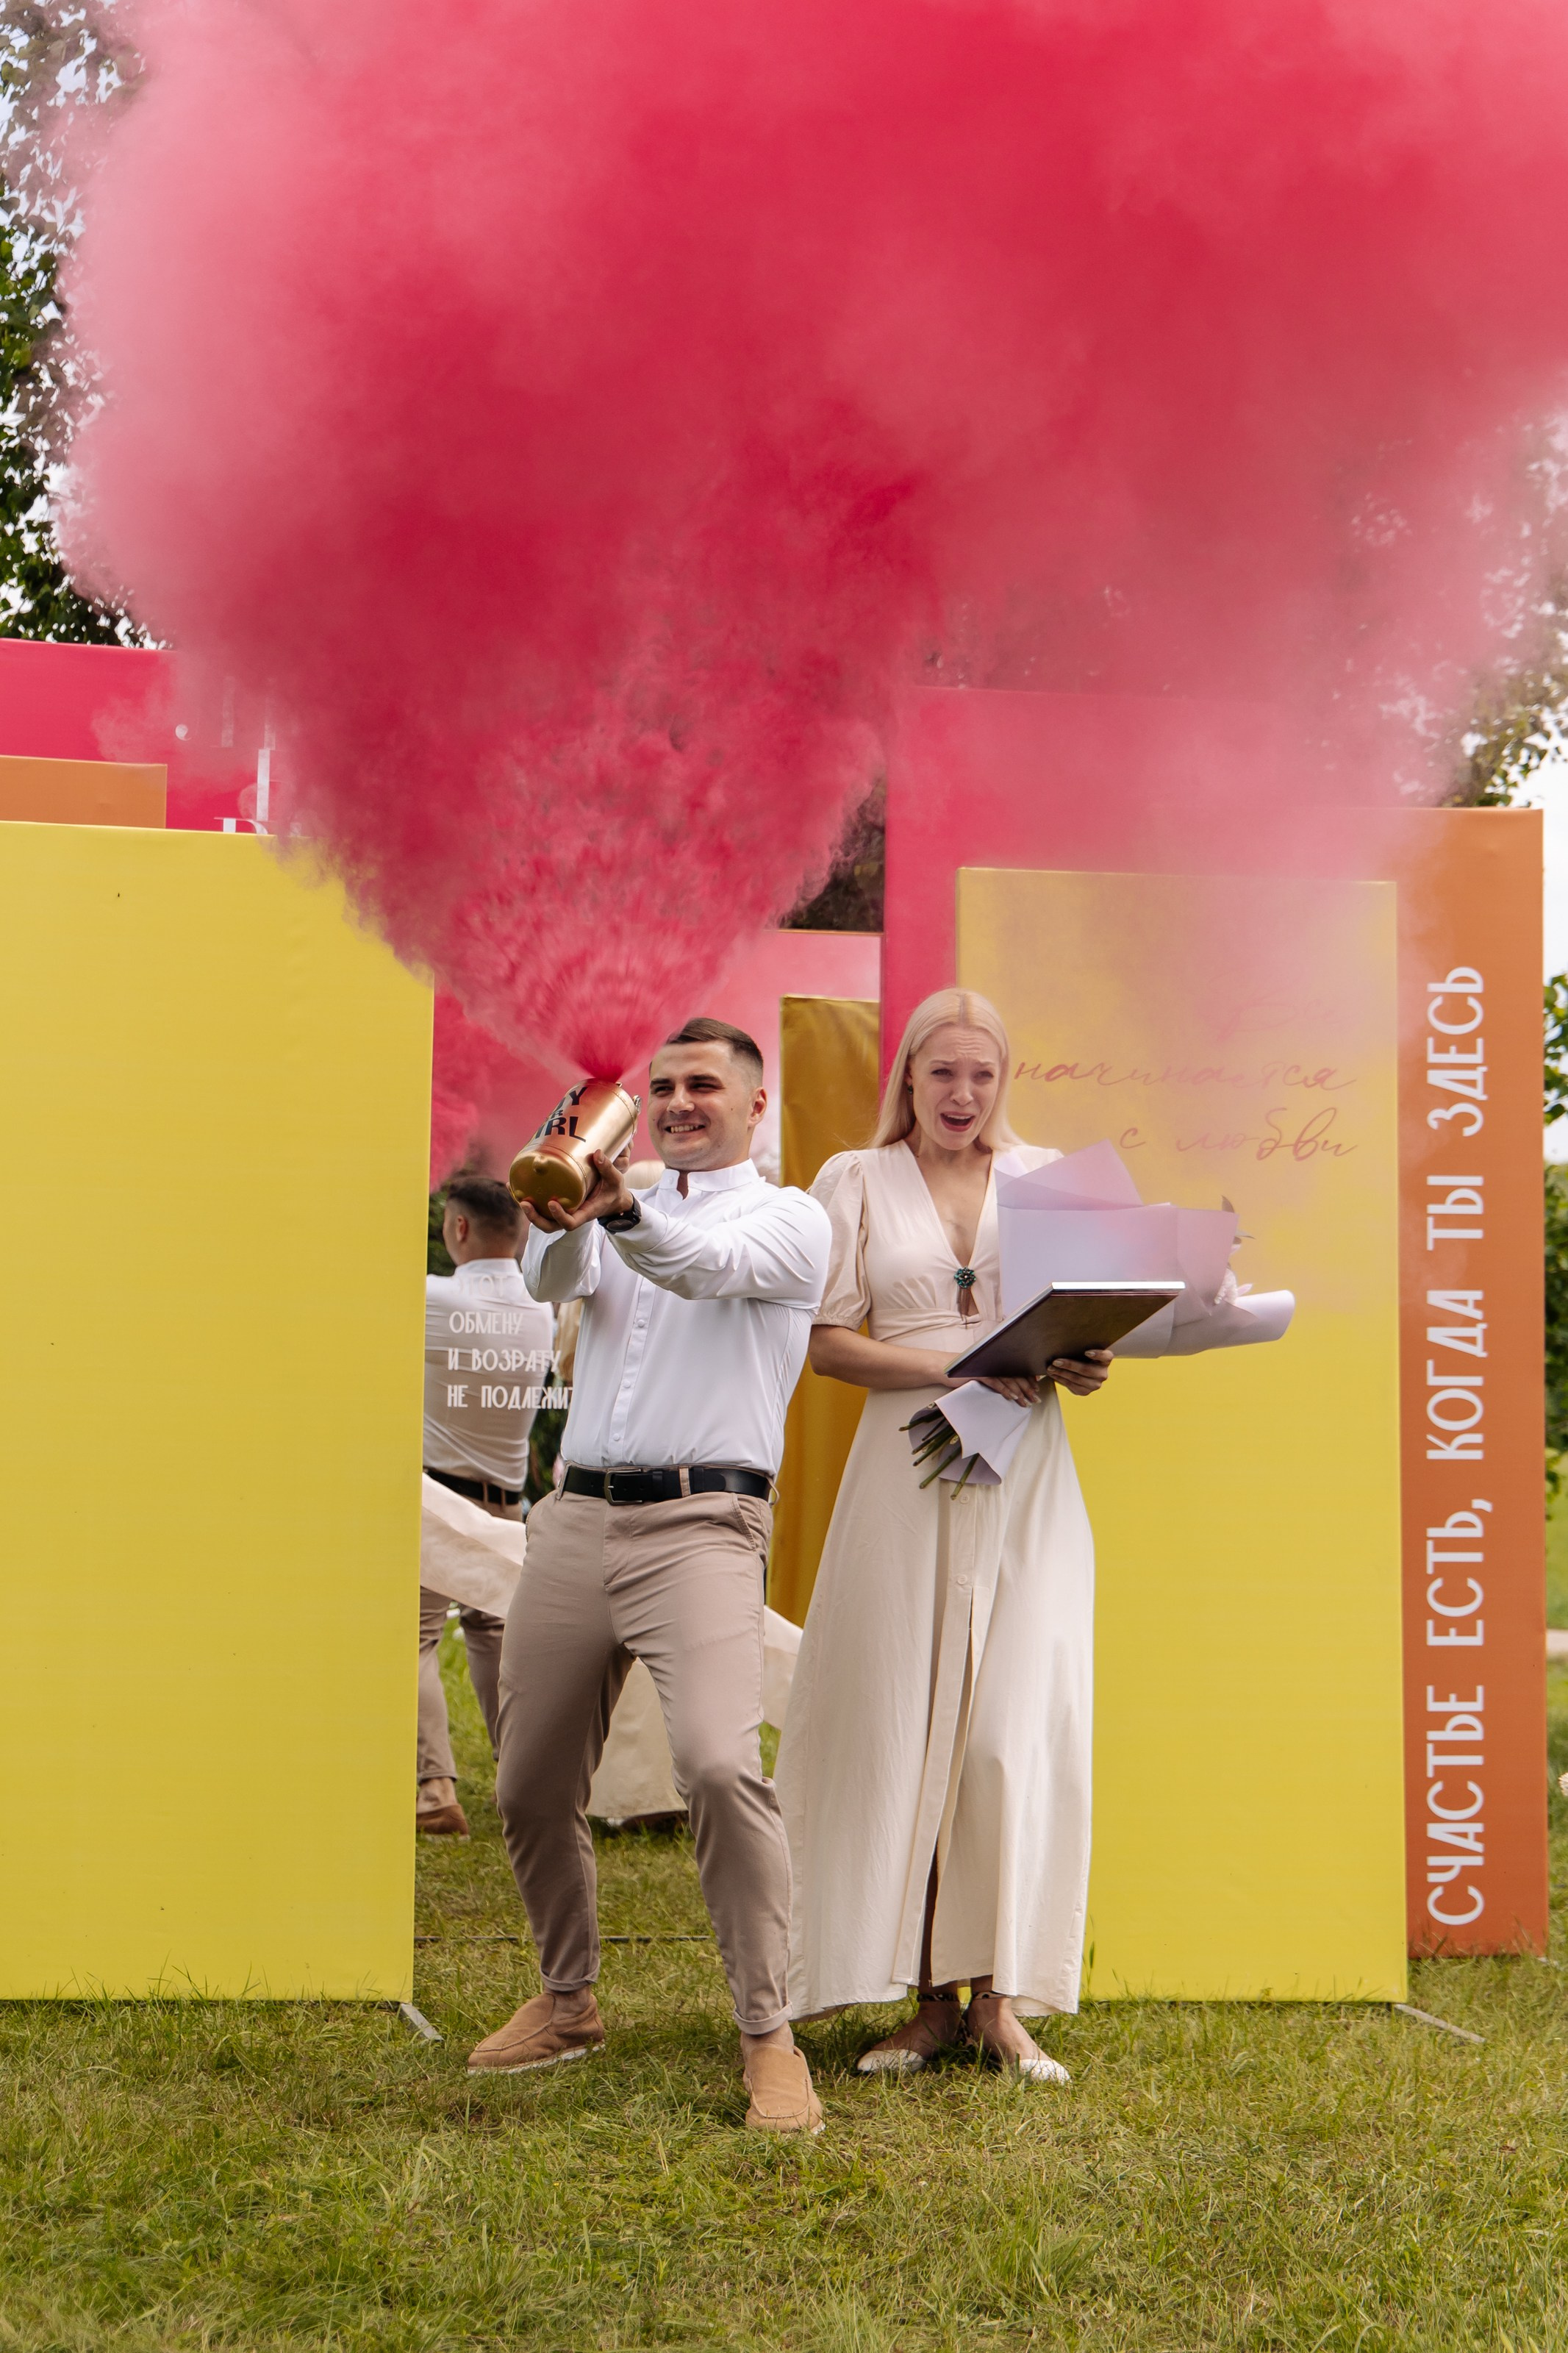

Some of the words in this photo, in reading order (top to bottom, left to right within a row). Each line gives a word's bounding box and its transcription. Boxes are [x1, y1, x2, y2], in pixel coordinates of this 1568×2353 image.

[1013, 1061, 1357, 1091] начинается
[1427, 966, 1488, 1136] ЗДЕСЬ
[534, 1115, 587, 1143] IRL
[1119, 1126, 1146, 1150] с
[1175, 1107, 1358, 1162] любви
[1428, 1176, 1483, 1250] ТЫ
[448, 1310, 524, 1335] ОБМЕНУ
[448, 1347, 459, 1371] И
[471, 1348, 562, 1373] ВОЗРАТУ
[1427, 1290, 1487, 1460] КОГДА
[447, 1385, 469, 1408] НЕ
[1428, 1499, 1492, 1646] ЕСТЬ,
[1428, 1686, 1483, 1925] СЧАСТЬЕ
